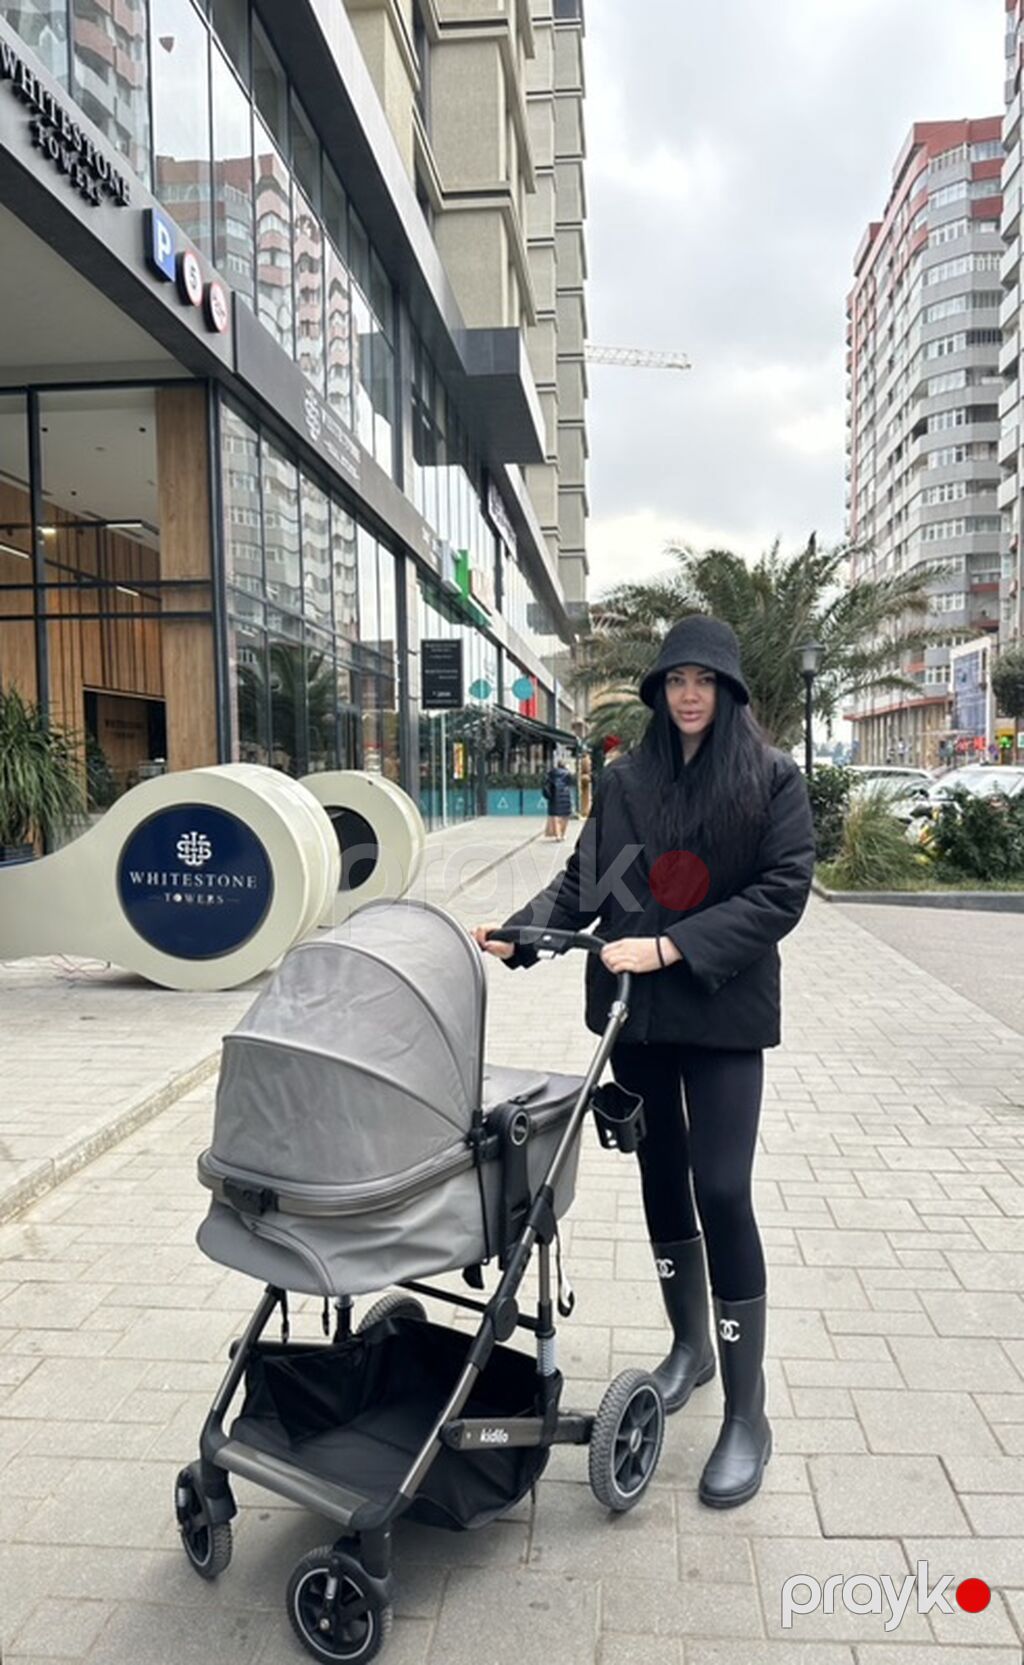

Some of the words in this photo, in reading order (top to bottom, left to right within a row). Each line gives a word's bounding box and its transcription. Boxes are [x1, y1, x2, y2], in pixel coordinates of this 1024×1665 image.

[0, 40, 131, 207] WHITESTONE
[157, 219, 172, 264] P
[129, 871, 258, 889] WHITESTONE
[164, 892, 225, 905] TOWERS
